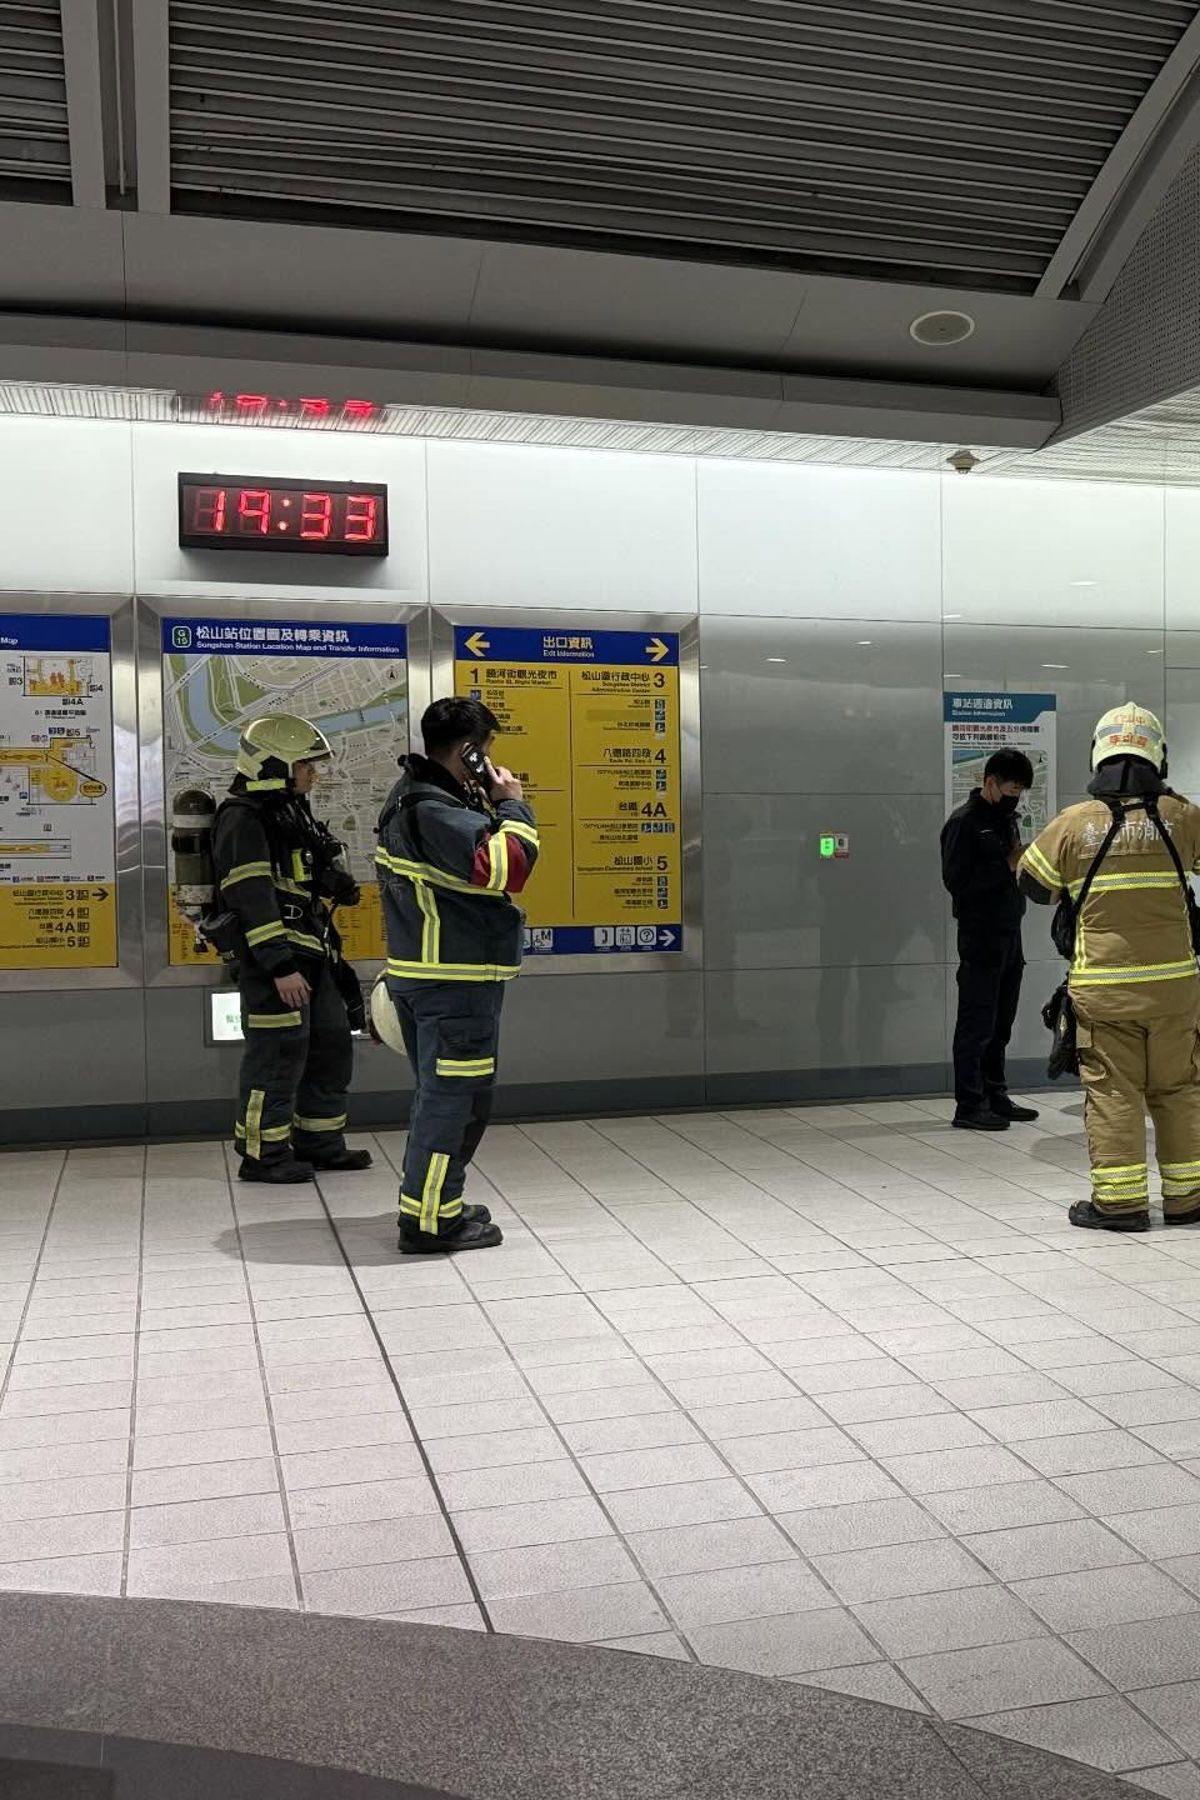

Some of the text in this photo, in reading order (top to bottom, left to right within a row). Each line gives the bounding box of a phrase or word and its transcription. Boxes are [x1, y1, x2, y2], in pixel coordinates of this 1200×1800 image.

[213, 489, 378, 541] 19:33
[235, 642, 260, 650] Station
[543, 636, 593, 649] 出口資訊
[470, 668, 478, 683] 1
[653, 672, 665, 688] 3
[655, 748, 666, 764] 4
[641, 802, 667, 817] 4A
[657, 855, 668, 871] 5
[66, 889, 75, 900] 3
[66, 907, 75, 919] 4
[55, 922, 75, 933] 4A
[67, 936, 76, 947] 5
